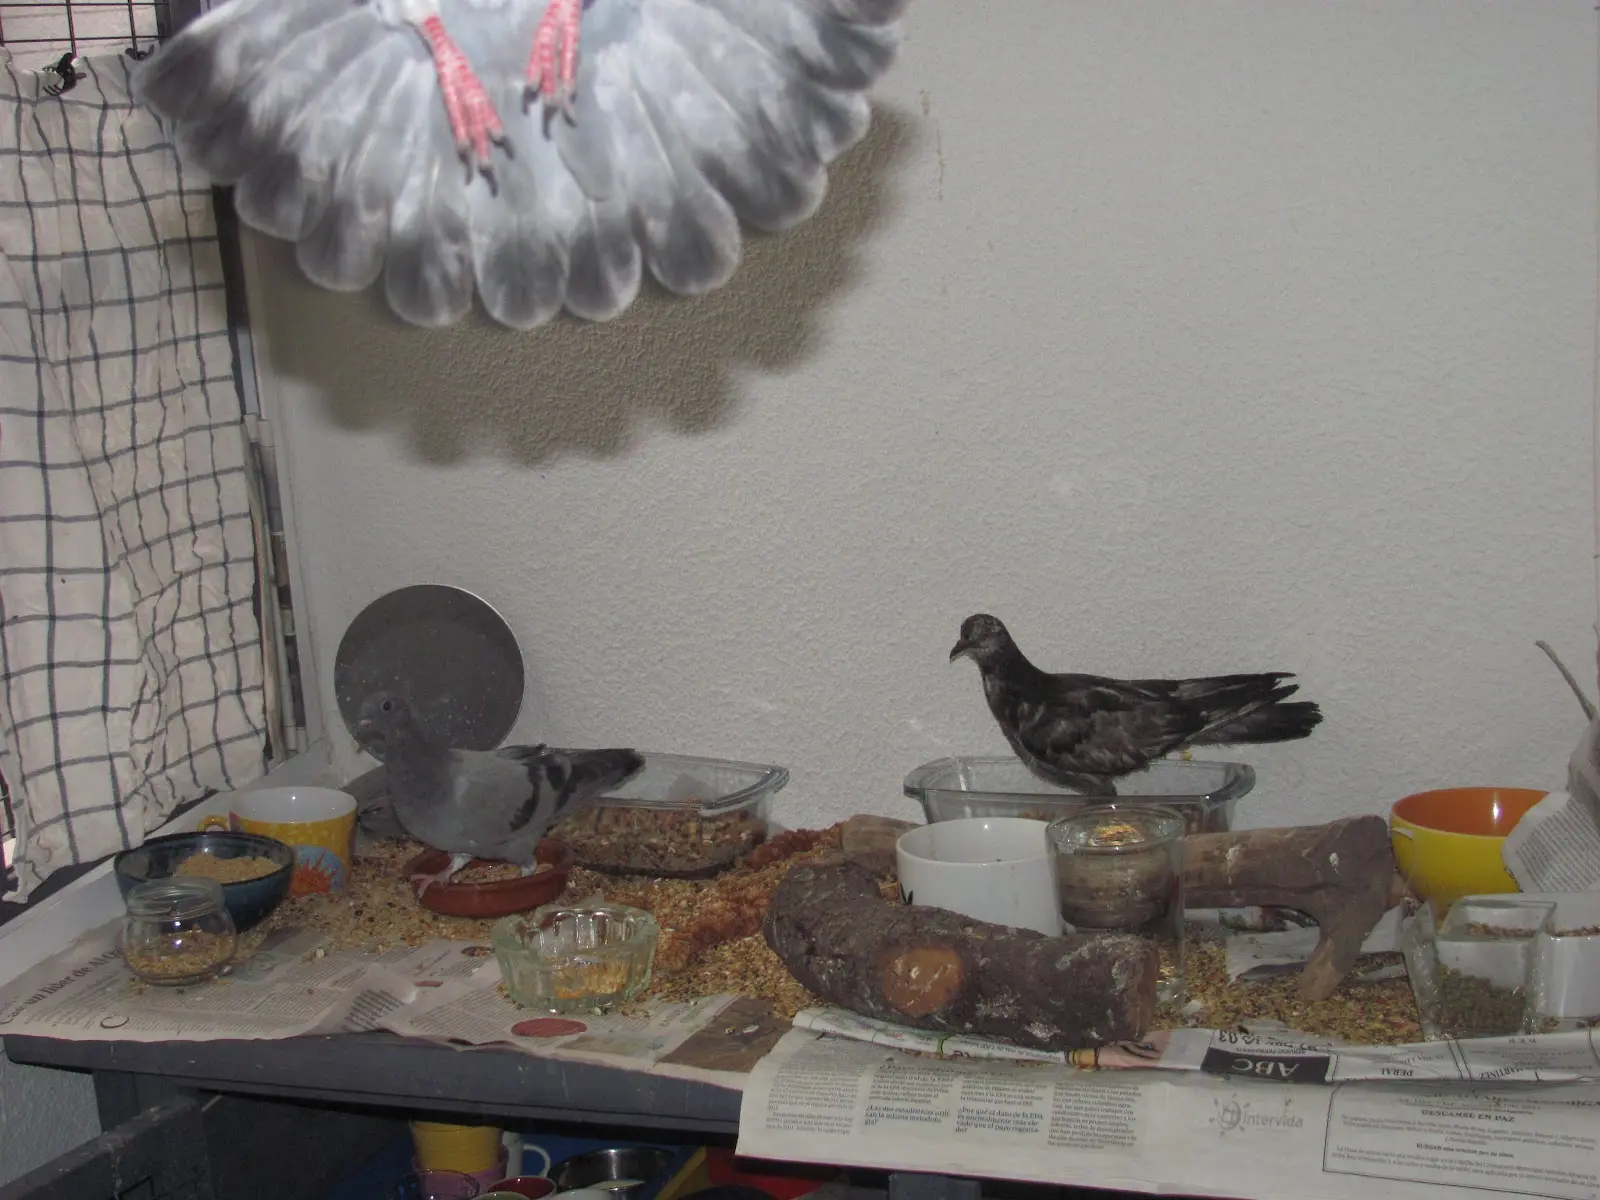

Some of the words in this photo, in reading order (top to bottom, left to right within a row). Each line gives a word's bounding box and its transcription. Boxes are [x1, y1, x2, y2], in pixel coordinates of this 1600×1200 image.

[25, 991, 48, 1005] un
[73, 965, 93, 978] de
[88, 956, 105, 967] Al
[1231, 1058, 1300, 1077] ABC
[1380, 1067, 1414, 1077] PERAL
[1421, 1109, 1476, 1121] DESCANSE
[1477, 1112, 1492, 1121] EN
[1493, 1114, 1516, 1123] PAZ
